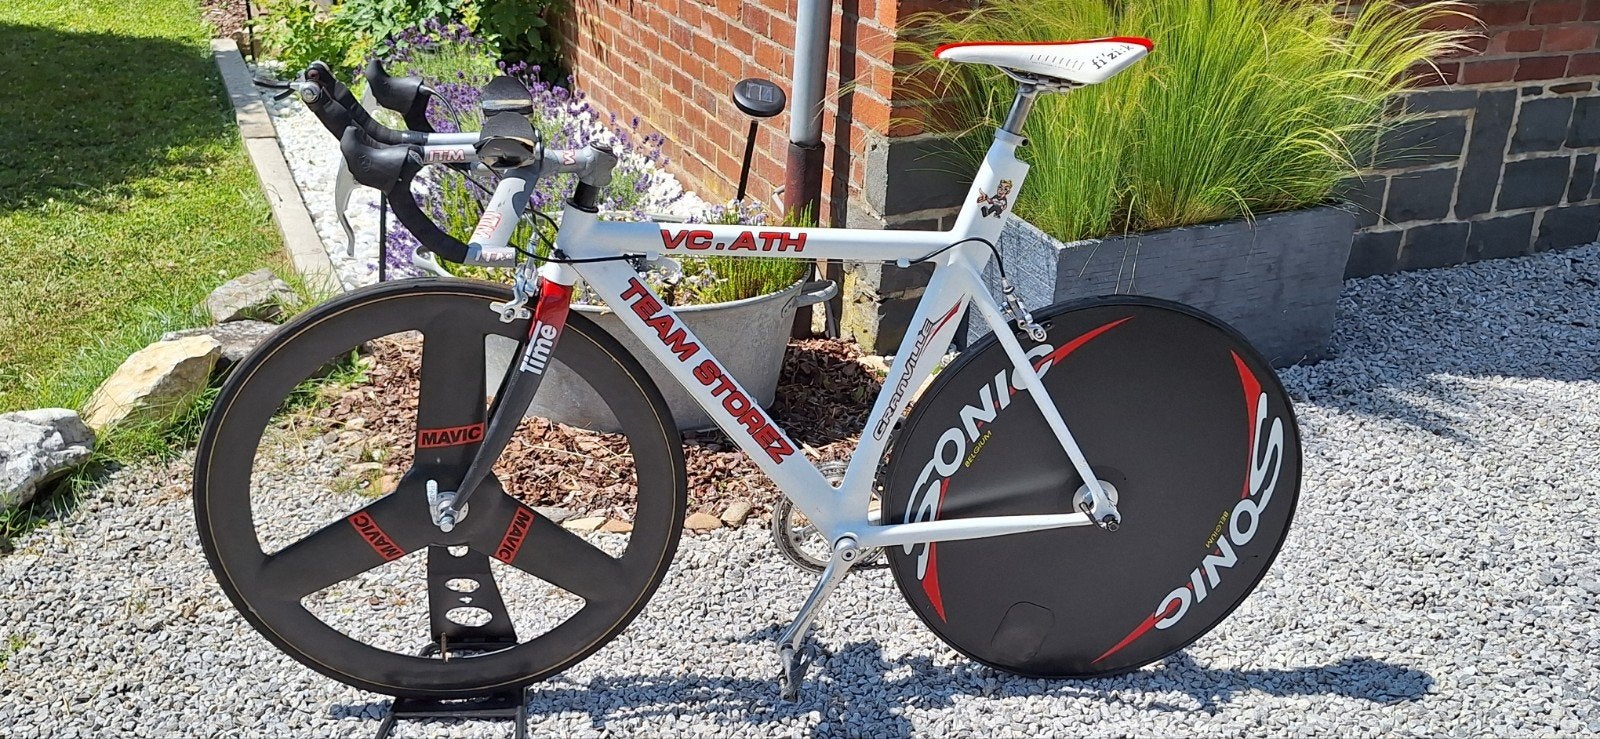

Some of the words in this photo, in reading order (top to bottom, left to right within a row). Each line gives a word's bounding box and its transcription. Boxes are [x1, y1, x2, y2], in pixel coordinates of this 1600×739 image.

[428, 149, 465, 161] ITM
[619, 277, 700, 362] TEAM
[692, 358, 795, 464] STOREZ
[421, 426, 481, 446] MAVIC
[964, 430, 993, 469] BELGIUM
[903, 344, 1054, 580] SONIC
[1155, 392, 1284, 630] SONIC
[1205, 510, 1229, 548] BELGIUM
[353, 515, 401, 558] MAVIC
[497, 512, 531, 561] MAVIC
